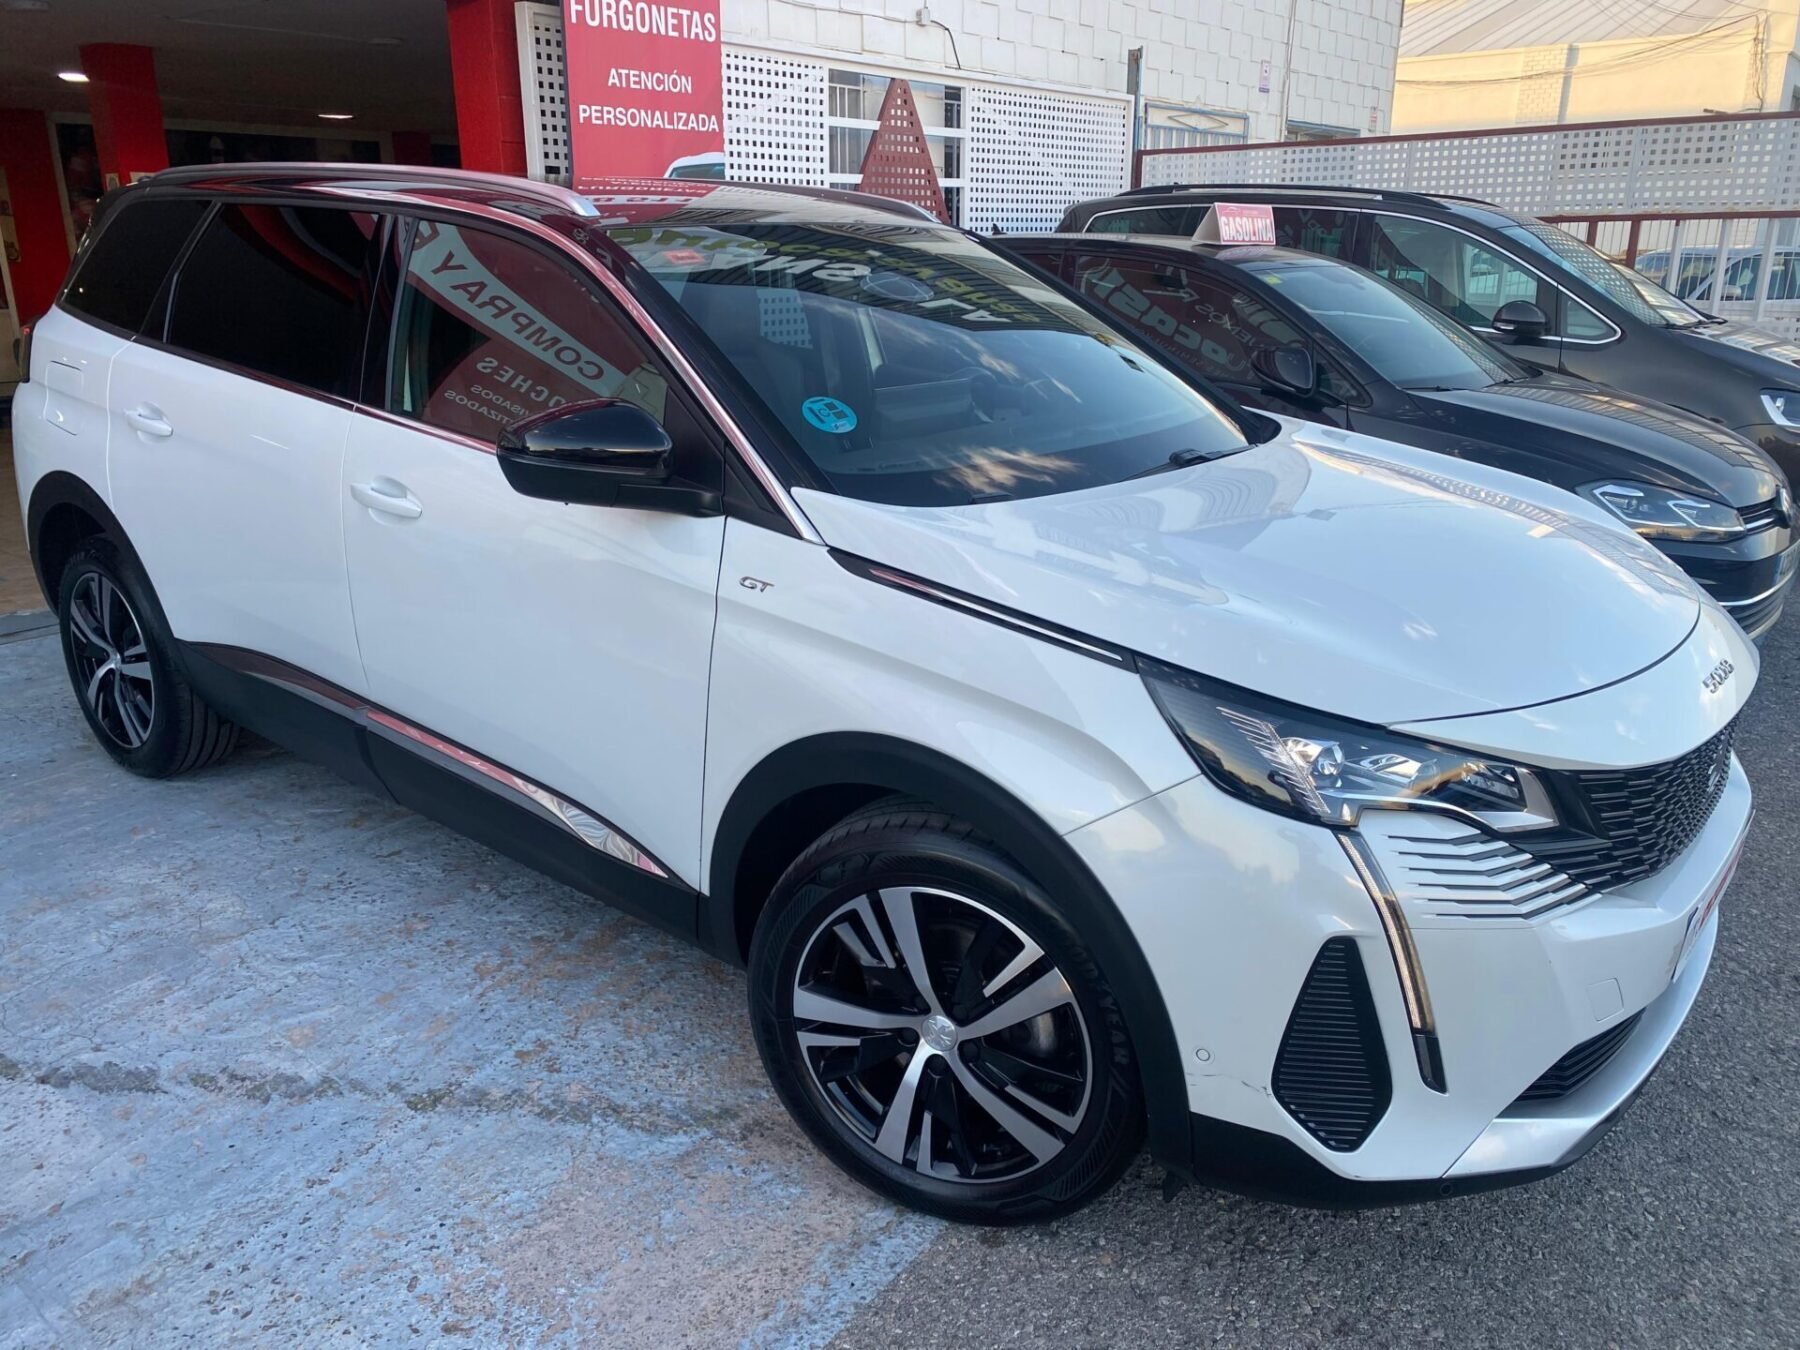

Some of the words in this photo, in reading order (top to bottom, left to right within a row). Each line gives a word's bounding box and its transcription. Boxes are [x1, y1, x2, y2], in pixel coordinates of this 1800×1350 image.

[571, 0, 716, 42] FURGONETAS
[608, 68, 692, 94] ATENCIÓN
[579, 104, 719, 132] PERSONALIZADA
[1220, 216, 1274, 242] GASOLINA
[739, 575, 775, 593] GT
[1702, 659, 1734, 694] 5008
